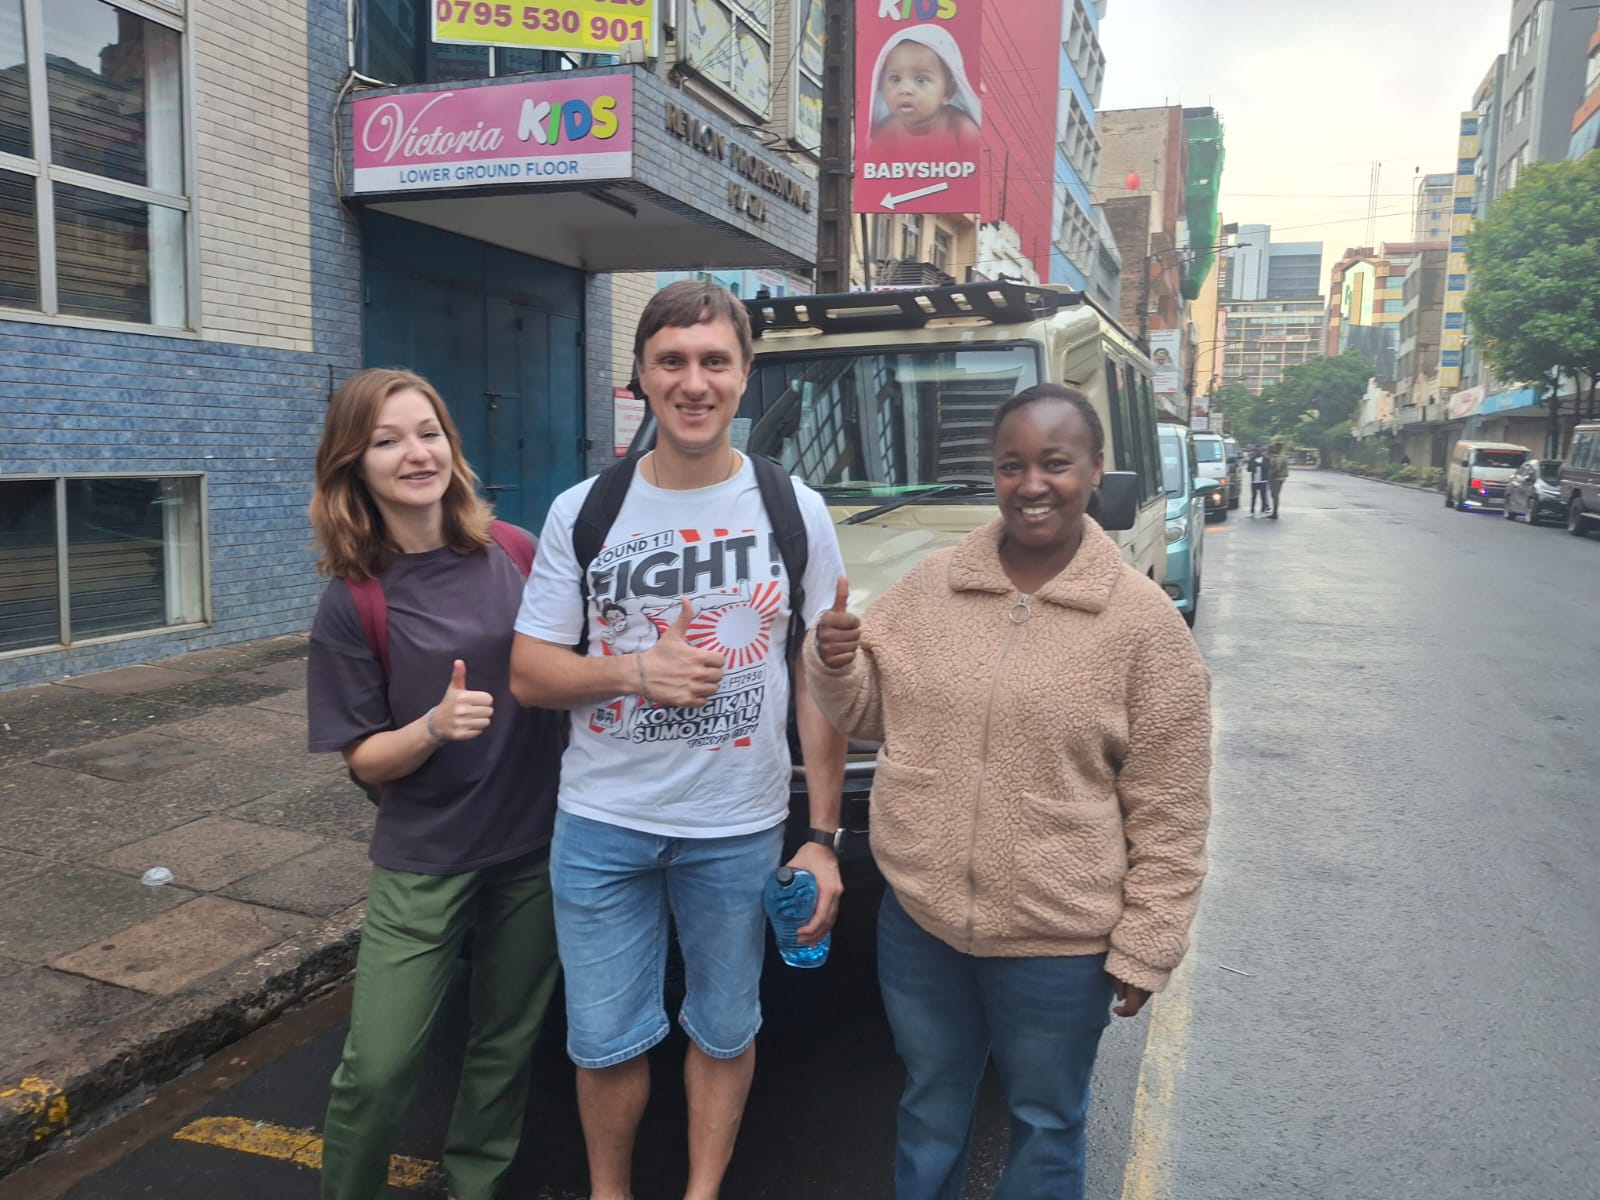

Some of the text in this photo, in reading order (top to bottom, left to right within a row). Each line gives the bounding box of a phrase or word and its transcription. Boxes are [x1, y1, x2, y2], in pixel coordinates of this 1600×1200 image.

[436, 1, 645, 42] 0795 530 901
[362, 92, 619, 163] Victoria KIDS
[400, 160, 579, 184] LOWER GROUND FLOOR
[863, 161, 976, 179] BABYSHOP
[636, 685, 765, 727] KOKUGIKAN
[631, 718, 698, 744] SUMO
[687, 735, 729, 749] TOKYO
